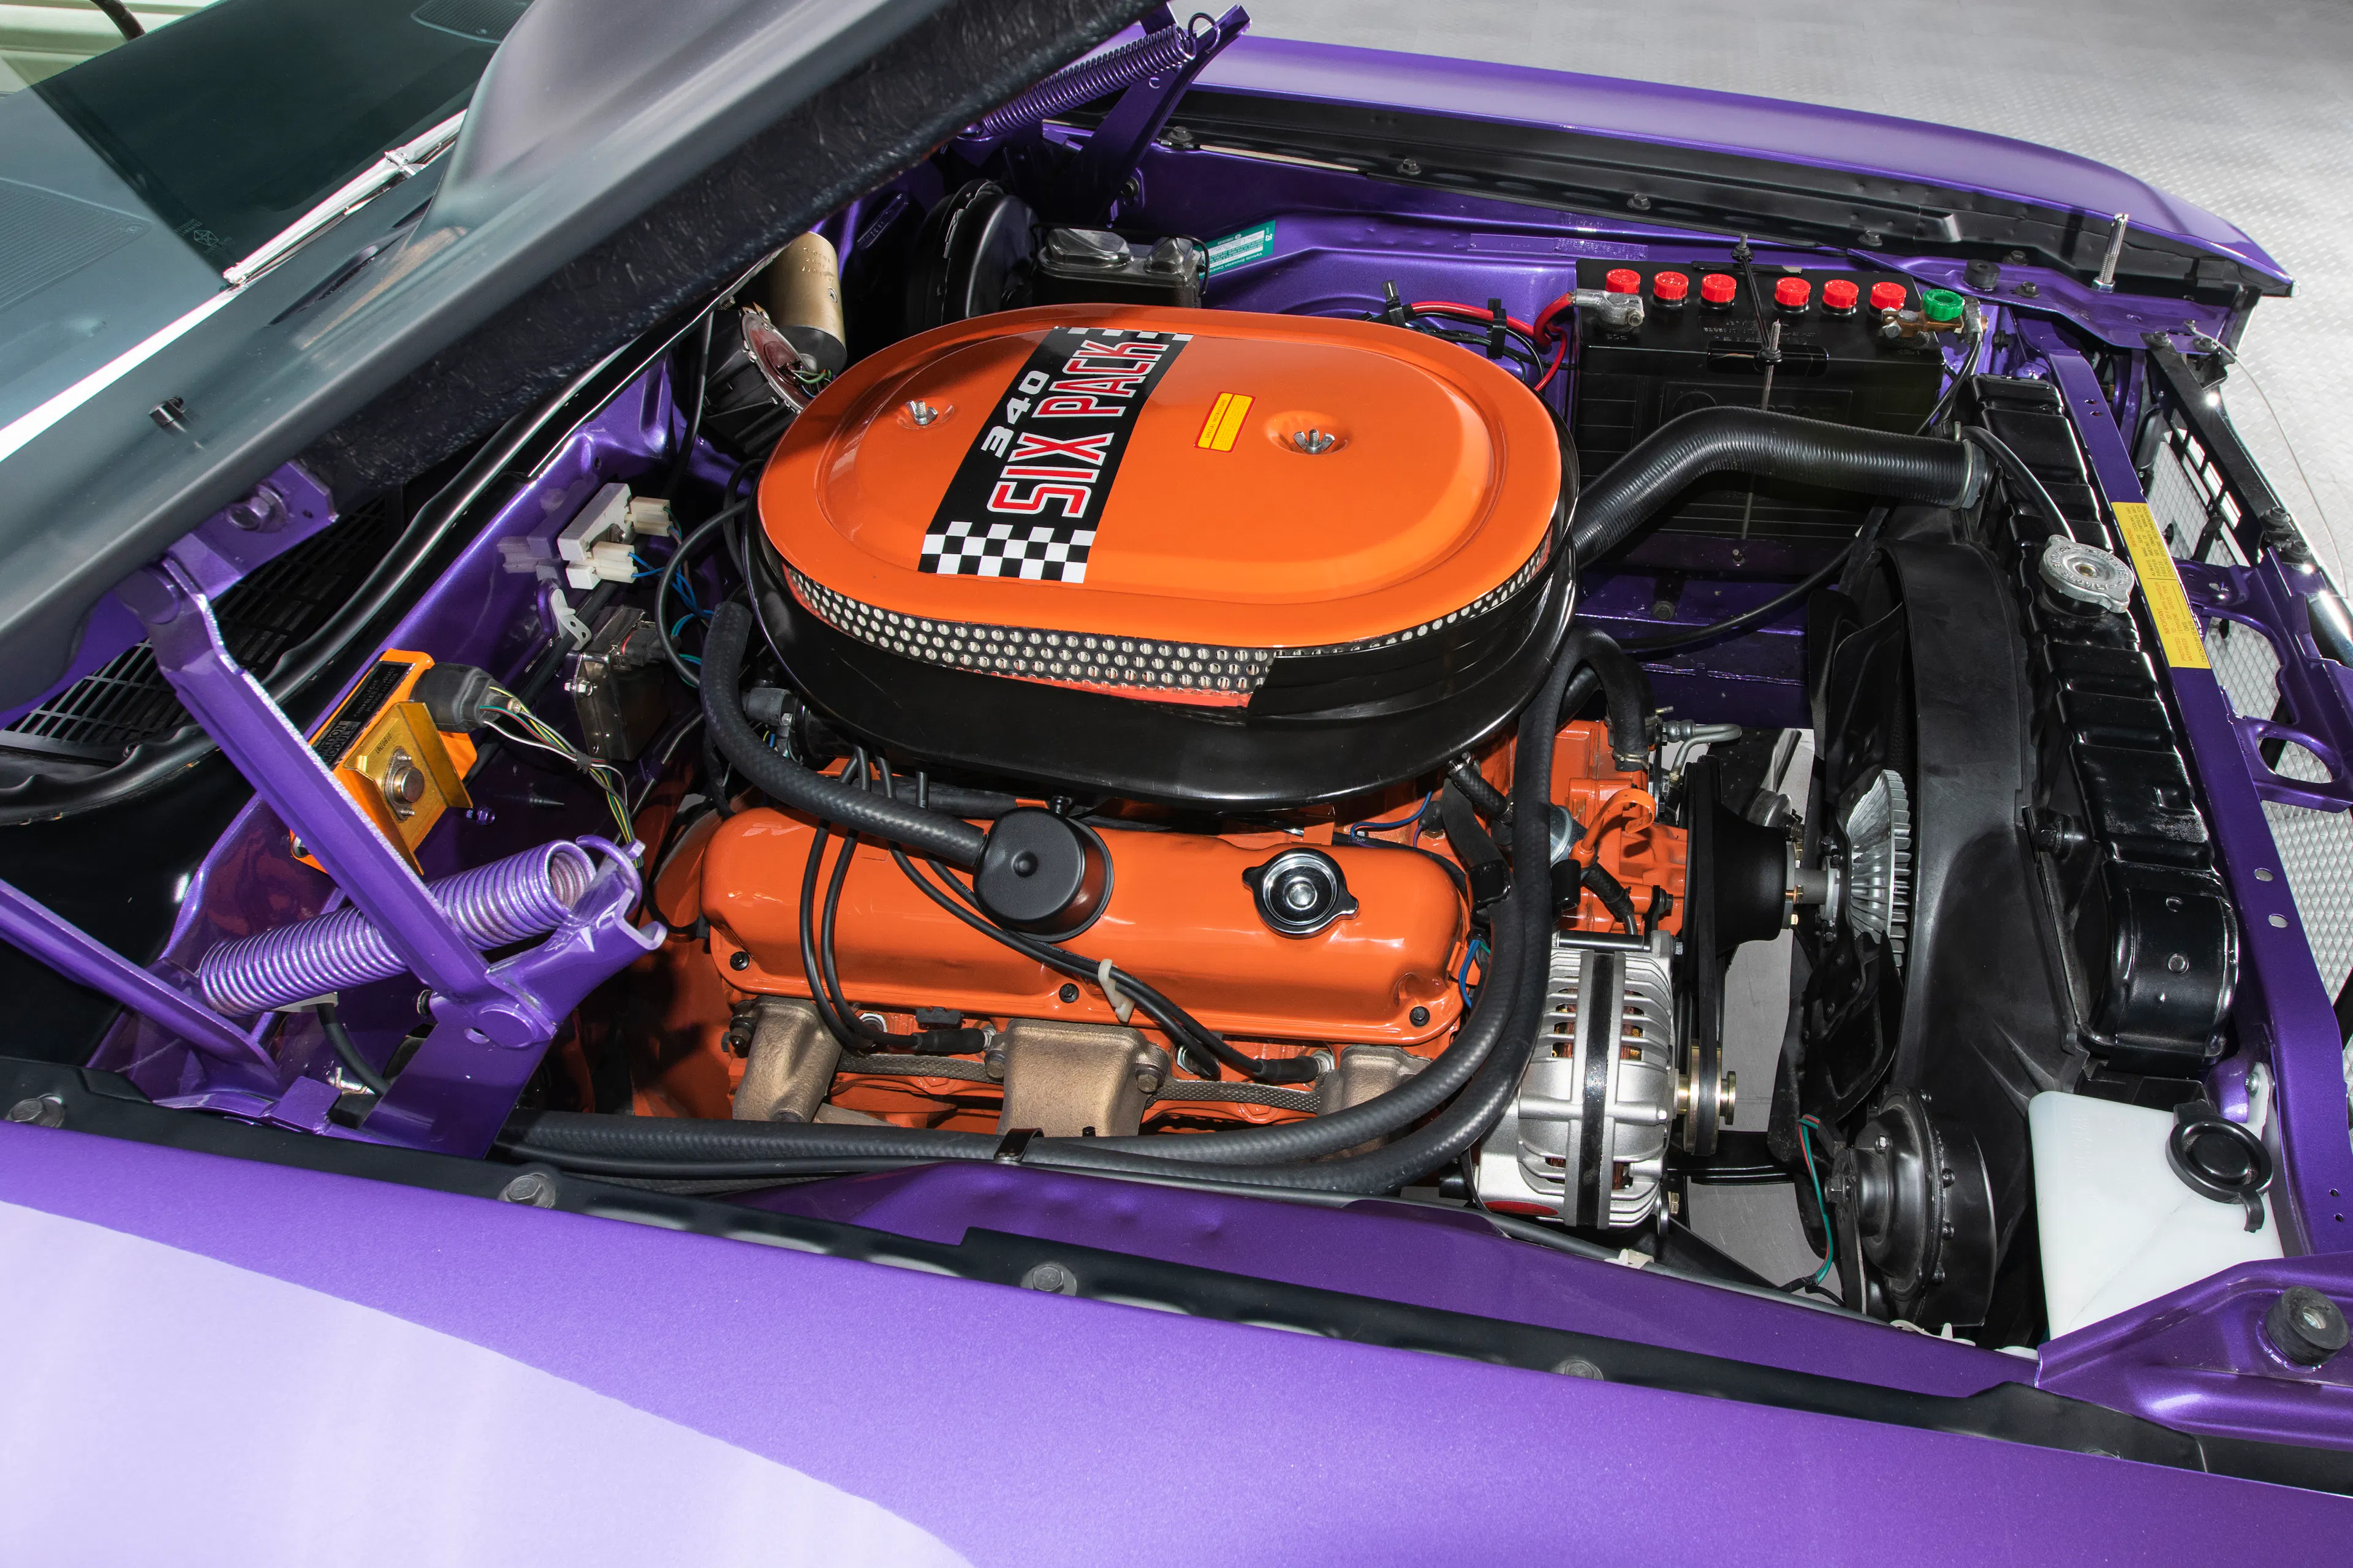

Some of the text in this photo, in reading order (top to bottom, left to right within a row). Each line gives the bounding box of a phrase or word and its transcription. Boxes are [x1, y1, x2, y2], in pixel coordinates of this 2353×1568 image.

[981, 370, 1050, 458] 340
[1205, 400, 1227, 438] SPECIAL INSTRUCTIONS
[987, 339, 1170, 518] SIX PACK
[2128, 515, 2139, 532] COOLANT
[2134, 514, 2144, 532] CHRYSLER
[2140, 513, 2148, 527] MANUAL
[2126, 528, 2137, 547] WARNING
[2142, 506, 2174, 577] COOLING SYSTEMS RECOMMENDATIONS
[2146, 530, 2156, 546] OWNER'S
[2145, 541, 2154, 556] AMOUNT
[2146, 559, 2156, 576] ALWAYS
[2151, 559, 2161, 577] PROPER
[2158, 561, 2167, 577] FREEZE
[2154, 582, 2164, 600] CHRYSLER
[2156, 608, 2170, 635] IMPORTANT
[2188, 620, 2198, 638] DEALER
[2174, 637, 2186, 662] PROTECTED
[2181, 637, 2194, 662] ANTIFREEZE
[2196, 642, 2207, 662] CHECKED
[353, 691, 377, 718] CHRYSLER
[316, 725, 346, 754] NITION
